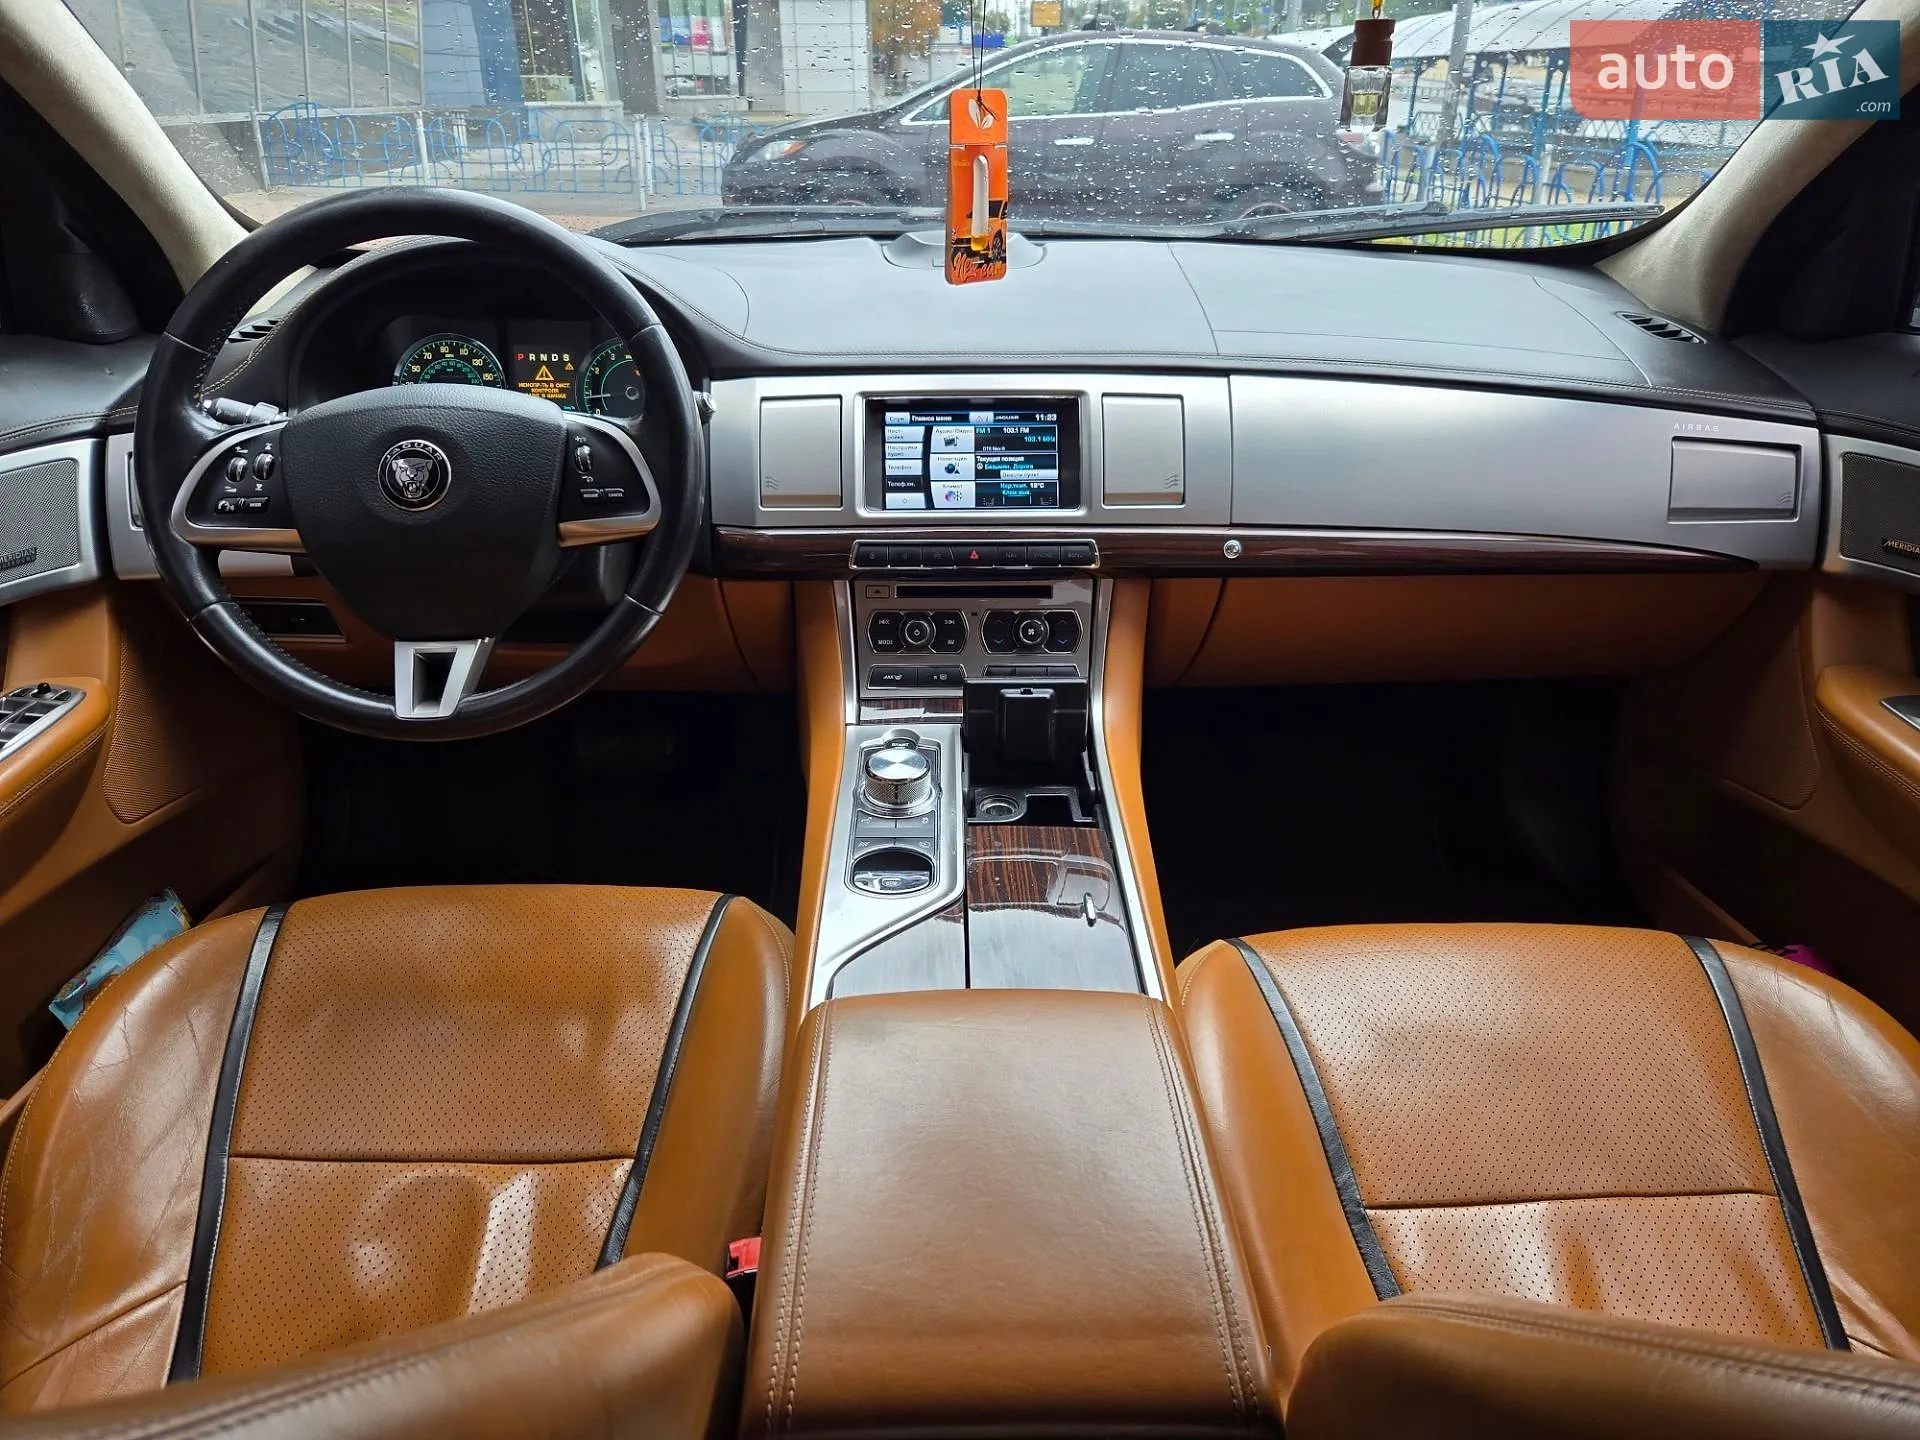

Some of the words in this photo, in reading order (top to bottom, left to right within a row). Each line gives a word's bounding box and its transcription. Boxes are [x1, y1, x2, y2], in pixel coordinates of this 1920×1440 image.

[518, 353, 525, 361] P
[529, 353, 536, 361] R
[540, 353, 548, 361] N
[551, 353, 559, 361] D
[563, 353, 570, 361] S
[594, 367, 600, 375] 2
[1673, 423, 1720, 432] AIRBAG
[386, 442, 442, 462] JAGUAR
[1883, 540, 1920, 554] MERIDIA
